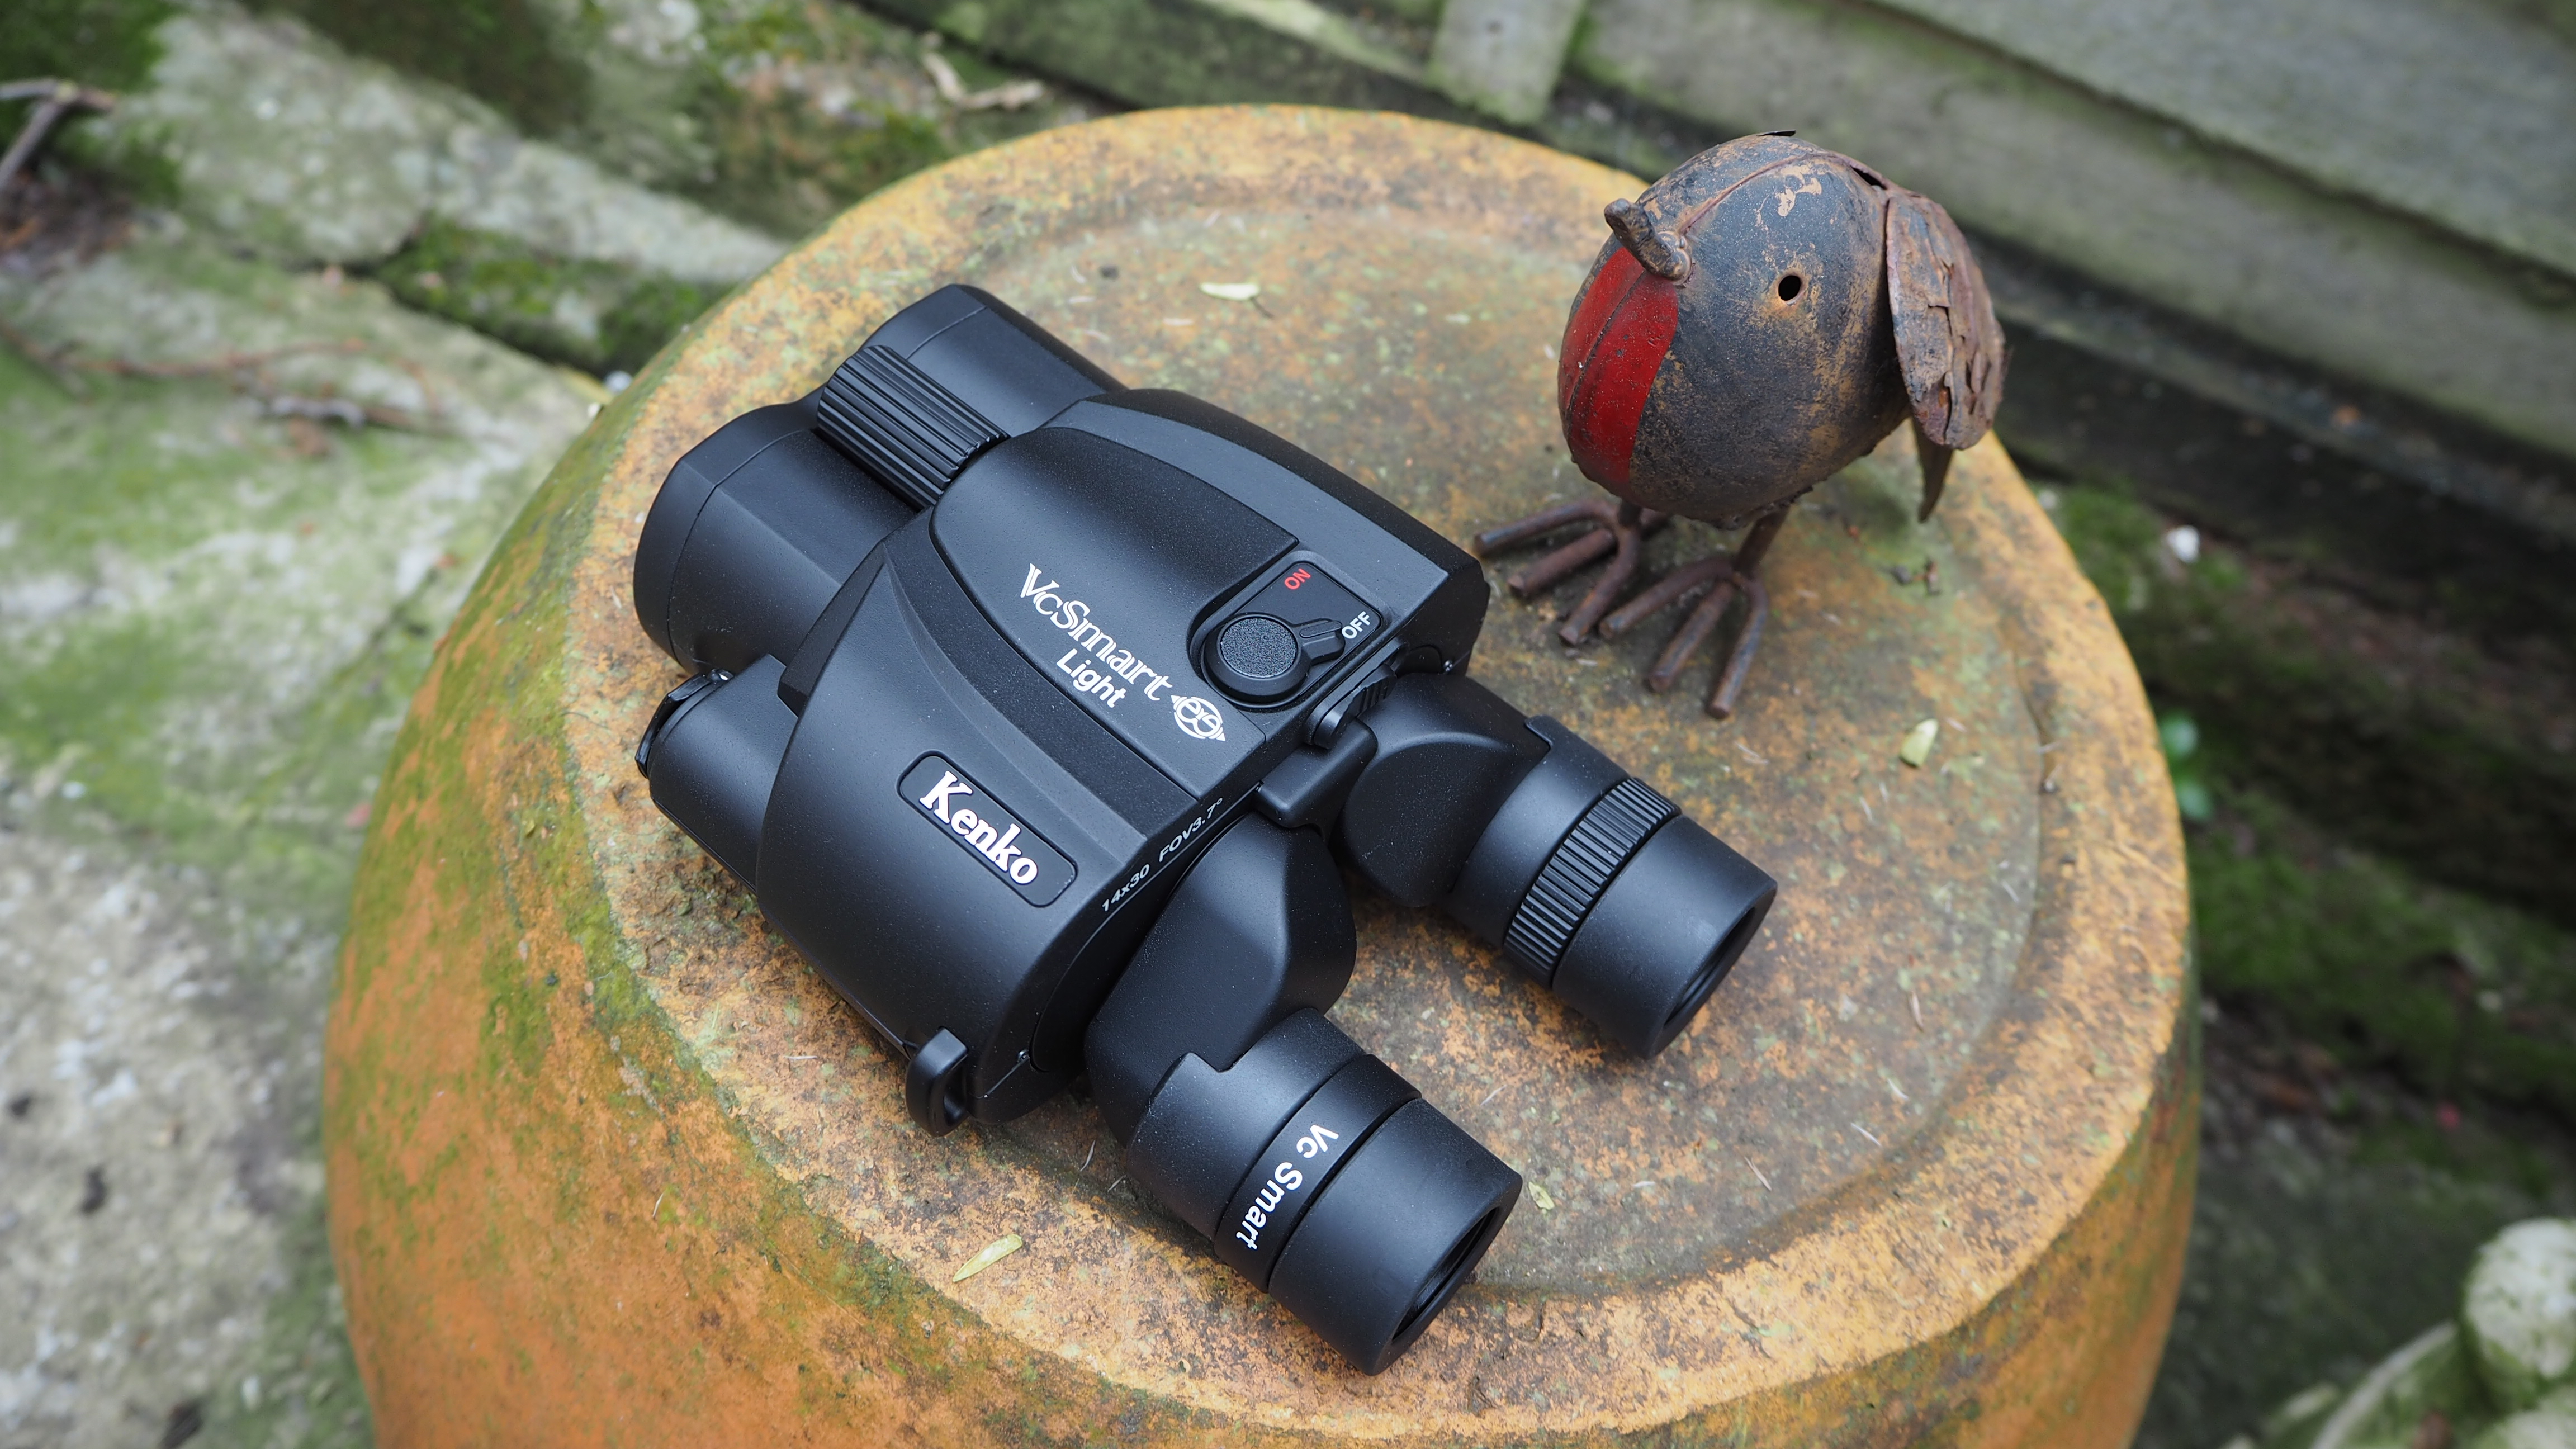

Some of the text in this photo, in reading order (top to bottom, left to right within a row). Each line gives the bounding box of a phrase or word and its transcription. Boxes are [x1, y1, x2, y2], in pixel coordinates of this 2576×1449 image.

[1284, 568, 1311, 590] ON
[1020, 564, 1173, 702] VcSmart
[1342, 610, 1372, 641] OFF
[1056, 648, 1127, 708] Light
[920, 771, 1038, 885] Kenko
[1102, 864, 1150, 912] 14x30
[1236, 1125, 1339, 1250] Vc Smart
